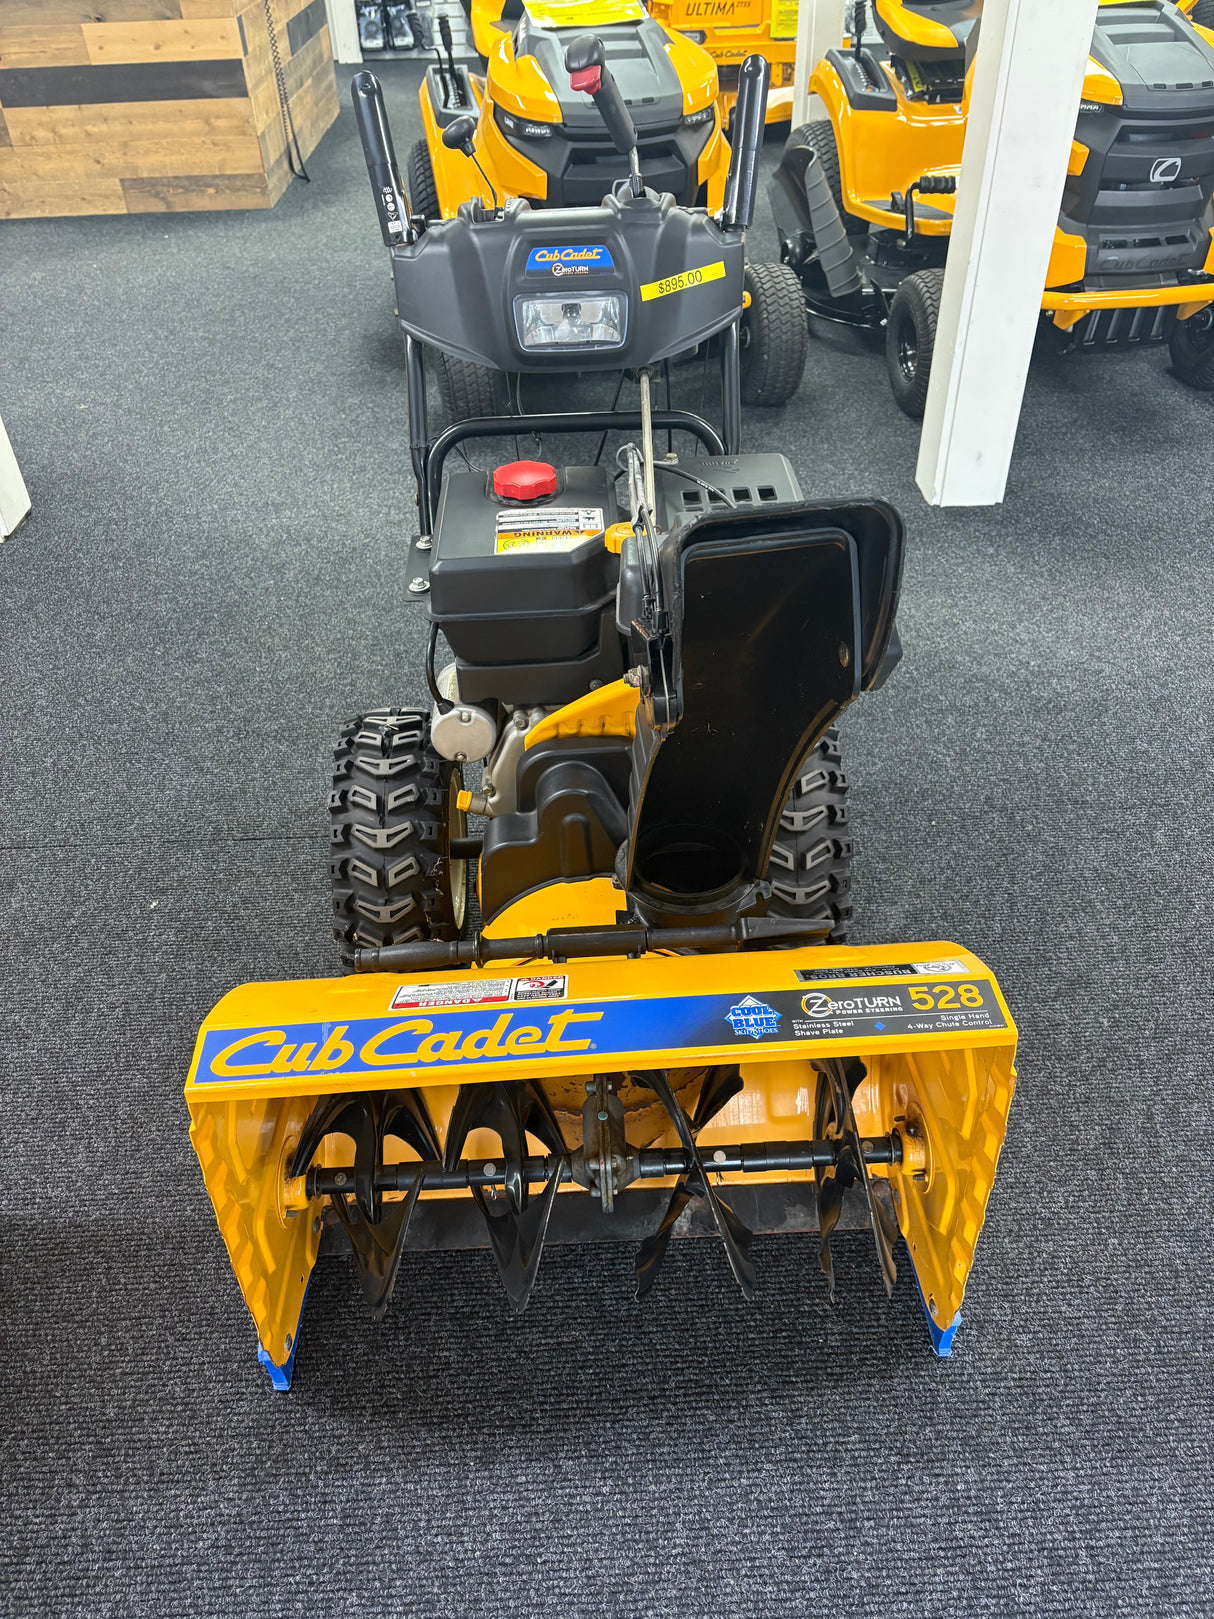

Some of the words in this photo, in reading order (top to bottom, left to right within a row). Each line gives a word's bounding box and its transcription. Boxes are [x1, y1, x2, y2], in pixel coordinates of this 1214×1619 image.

[686, 2, 735, 16] ULTIMA
[535, 249, 560, 262] Cub
[560, 248, 603, 261] Cadet
[658, 270, 703, 294] $895.00
[513, 530, 572, 538] WARNING
[419, 997, 470, 1007] DANGER
[803, 993, 902, 1015] ZeroTURN
[908, 984, 984, 1011] 528
[731, 1004, 774, 1017] COOL
[865, 1006, 904, 1014] STEERING
[732, 1016, 777, 1029] BLUE
[793, 1022, 831, 1030] Stainless
[833, 1020, 854, 1028] Steel
[907, 1022, 934, 1030] 4-Way
[794, 1029, 821, 1037] Shave
[822, 1027, 844, 1035] Plate
[210, 1025, 354, 1077] Cub
[360, 1009, 604, 1066] Cadet
